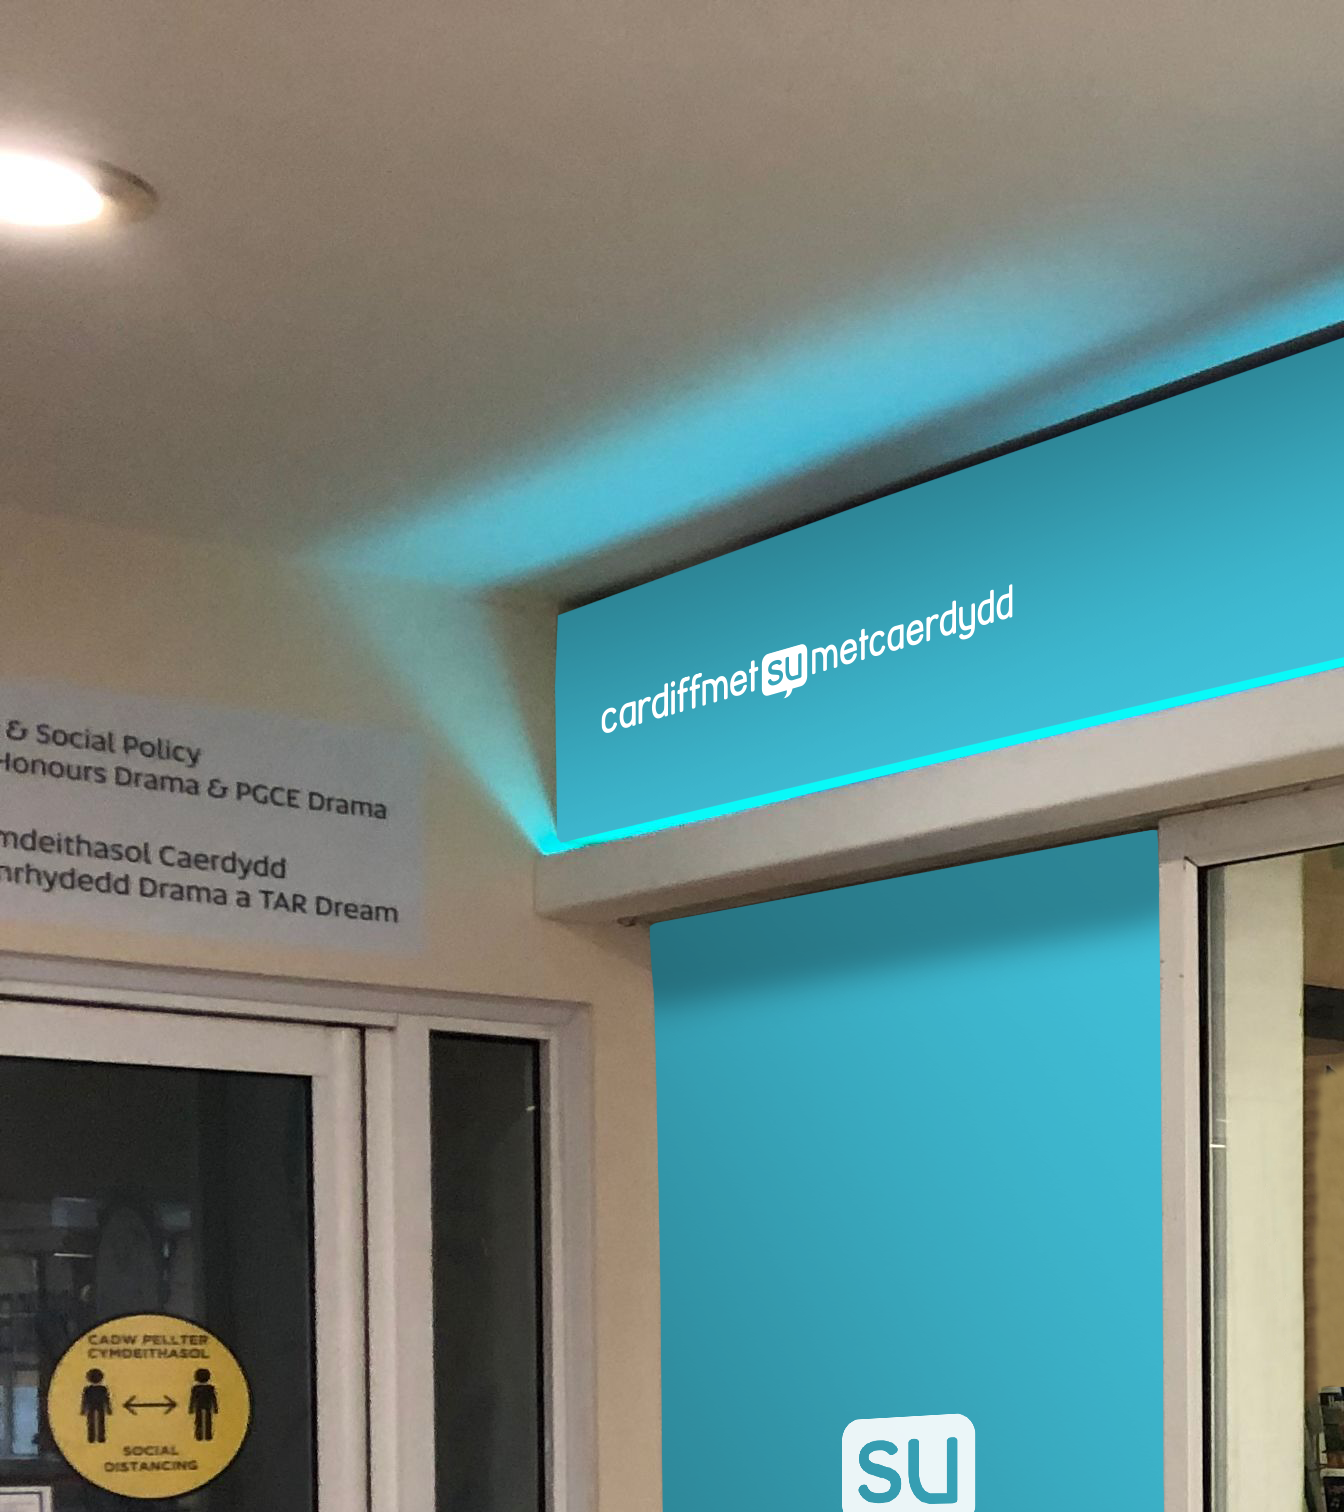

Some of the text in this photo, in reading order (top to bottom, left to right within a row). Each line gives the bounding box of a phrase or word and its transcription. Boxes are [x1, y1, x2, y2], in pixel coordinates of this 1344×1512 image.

[6, 720, 201, 768] & Social Policy
[114, 766, 200, 796] Drama
[207, 778, 228, 799] &
[236, 781, 301, 809] PGCE
[308, 791, 387, 820] Drama
[159, 845, 287, 880] Caerdydd
[139, 876, 228, 906] Drama
[236, 889, 251, 908] a
[259, 890, 307, 914] TAR
[316, 895, 399, 923] Dream
[87, 1334, 209, 1345] CADW PELLTER
[87, 1348, 210, 1359] CYMDEITHASOL
[122, 1445, 180, 1457] SOCIAL
[104, 1460, 199, 1473] DISTANCING
